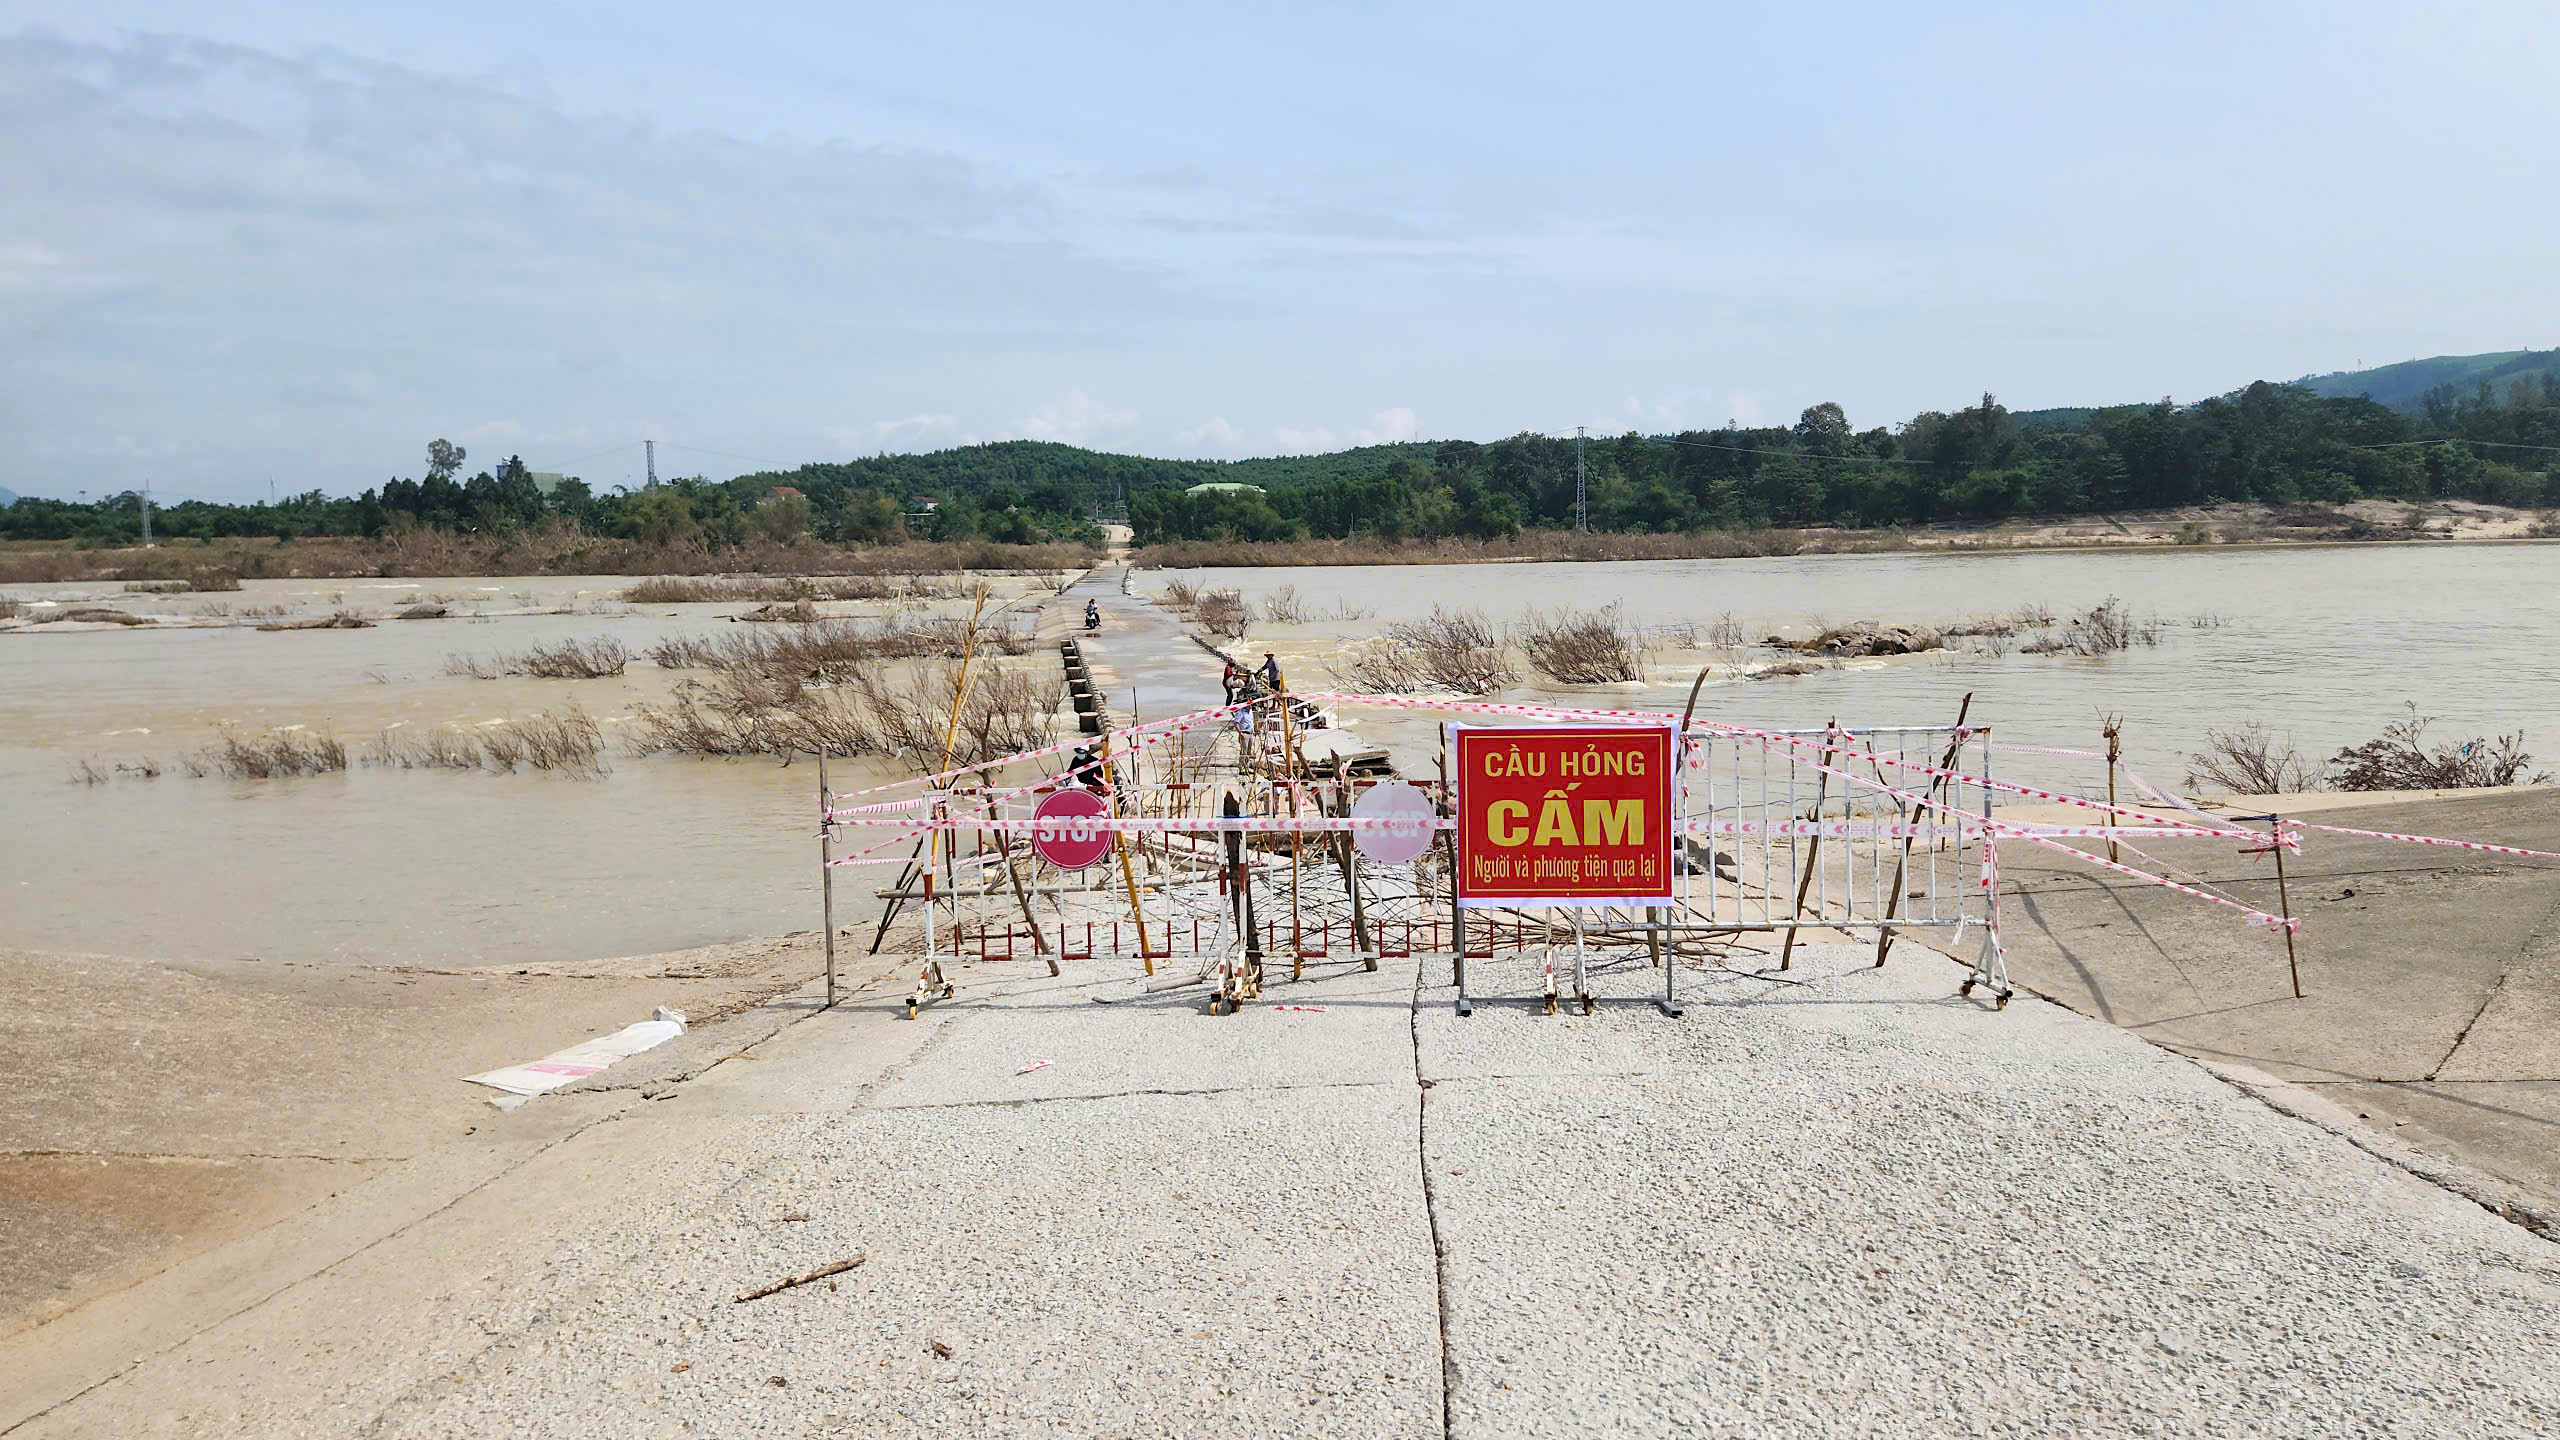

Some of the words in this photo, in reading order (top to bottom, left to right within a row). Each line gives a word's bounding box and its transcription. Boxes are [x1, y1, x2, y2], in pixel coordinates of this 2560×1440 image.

[1484, 743, 1546, 777] CẦU
[1560, 743, 1645, 777] HỎNG
[1039, 814, 1105, 843] STOP
[1487, 782, 1645, 847] CẤM
[1474, 854, 1510, 884] Người
[1514, 854, 1529, 878] và
[1533, 854, 1580, 883] phương
[1583, 853, 1608, 883] tiện
[1612, 859, 1636, 883] qua
[1640, 853, 1656, 882] lại
